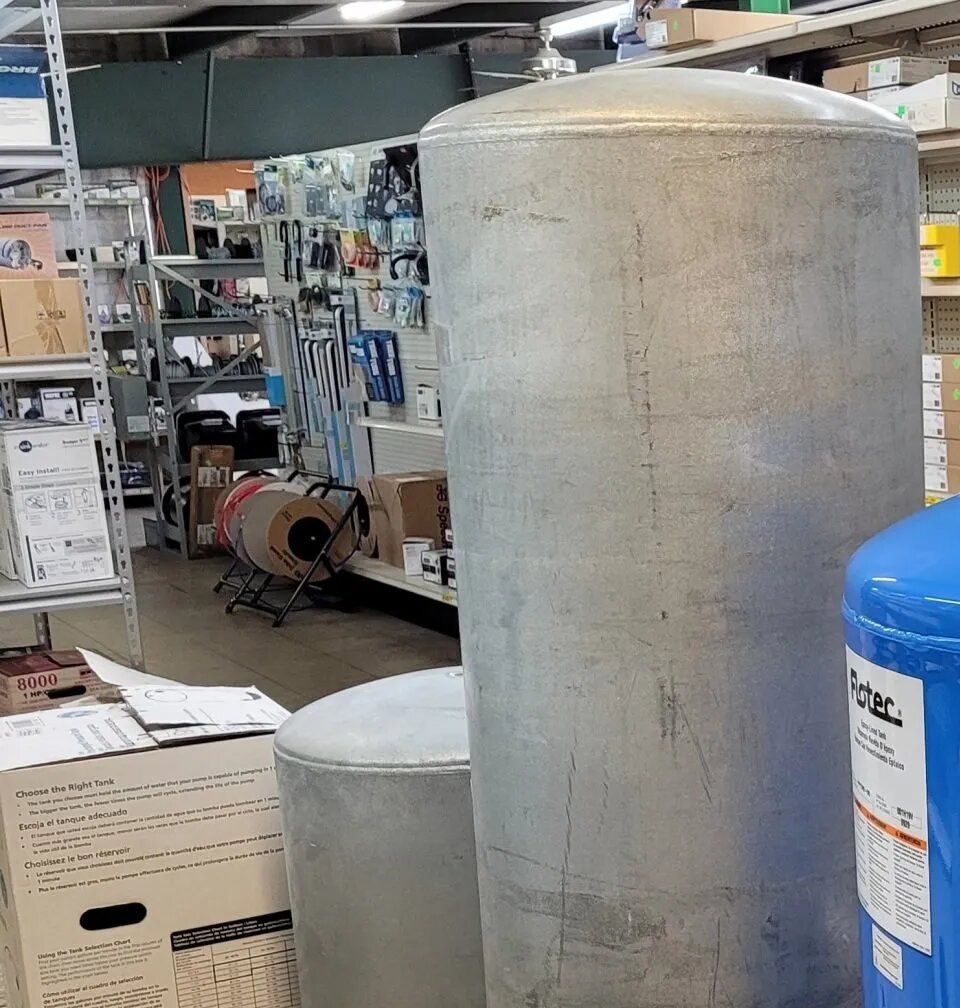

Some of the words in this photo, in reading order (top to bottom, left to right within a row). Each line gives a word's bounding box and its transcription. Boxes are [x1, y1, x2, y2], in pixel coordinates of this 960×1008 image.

[17, 673, 58, 692] 8000
[850, 667, 903, 728] Flotec
[16, 790, 49, 799] Choose
[68, 782, 93, 791] Right
[94, 778, 114, 786] Tank
[19, 822, 44, 831] Escoja
[56, 815, 85, 825] tanque
[88, 809, 128, 820] adecuado
[24, 857, 65, 869] Choisissez
[96, 846, 130, 858] réservoir
[37, 950, 55, 960] Using
[85, 942, 112, 951] Selection
